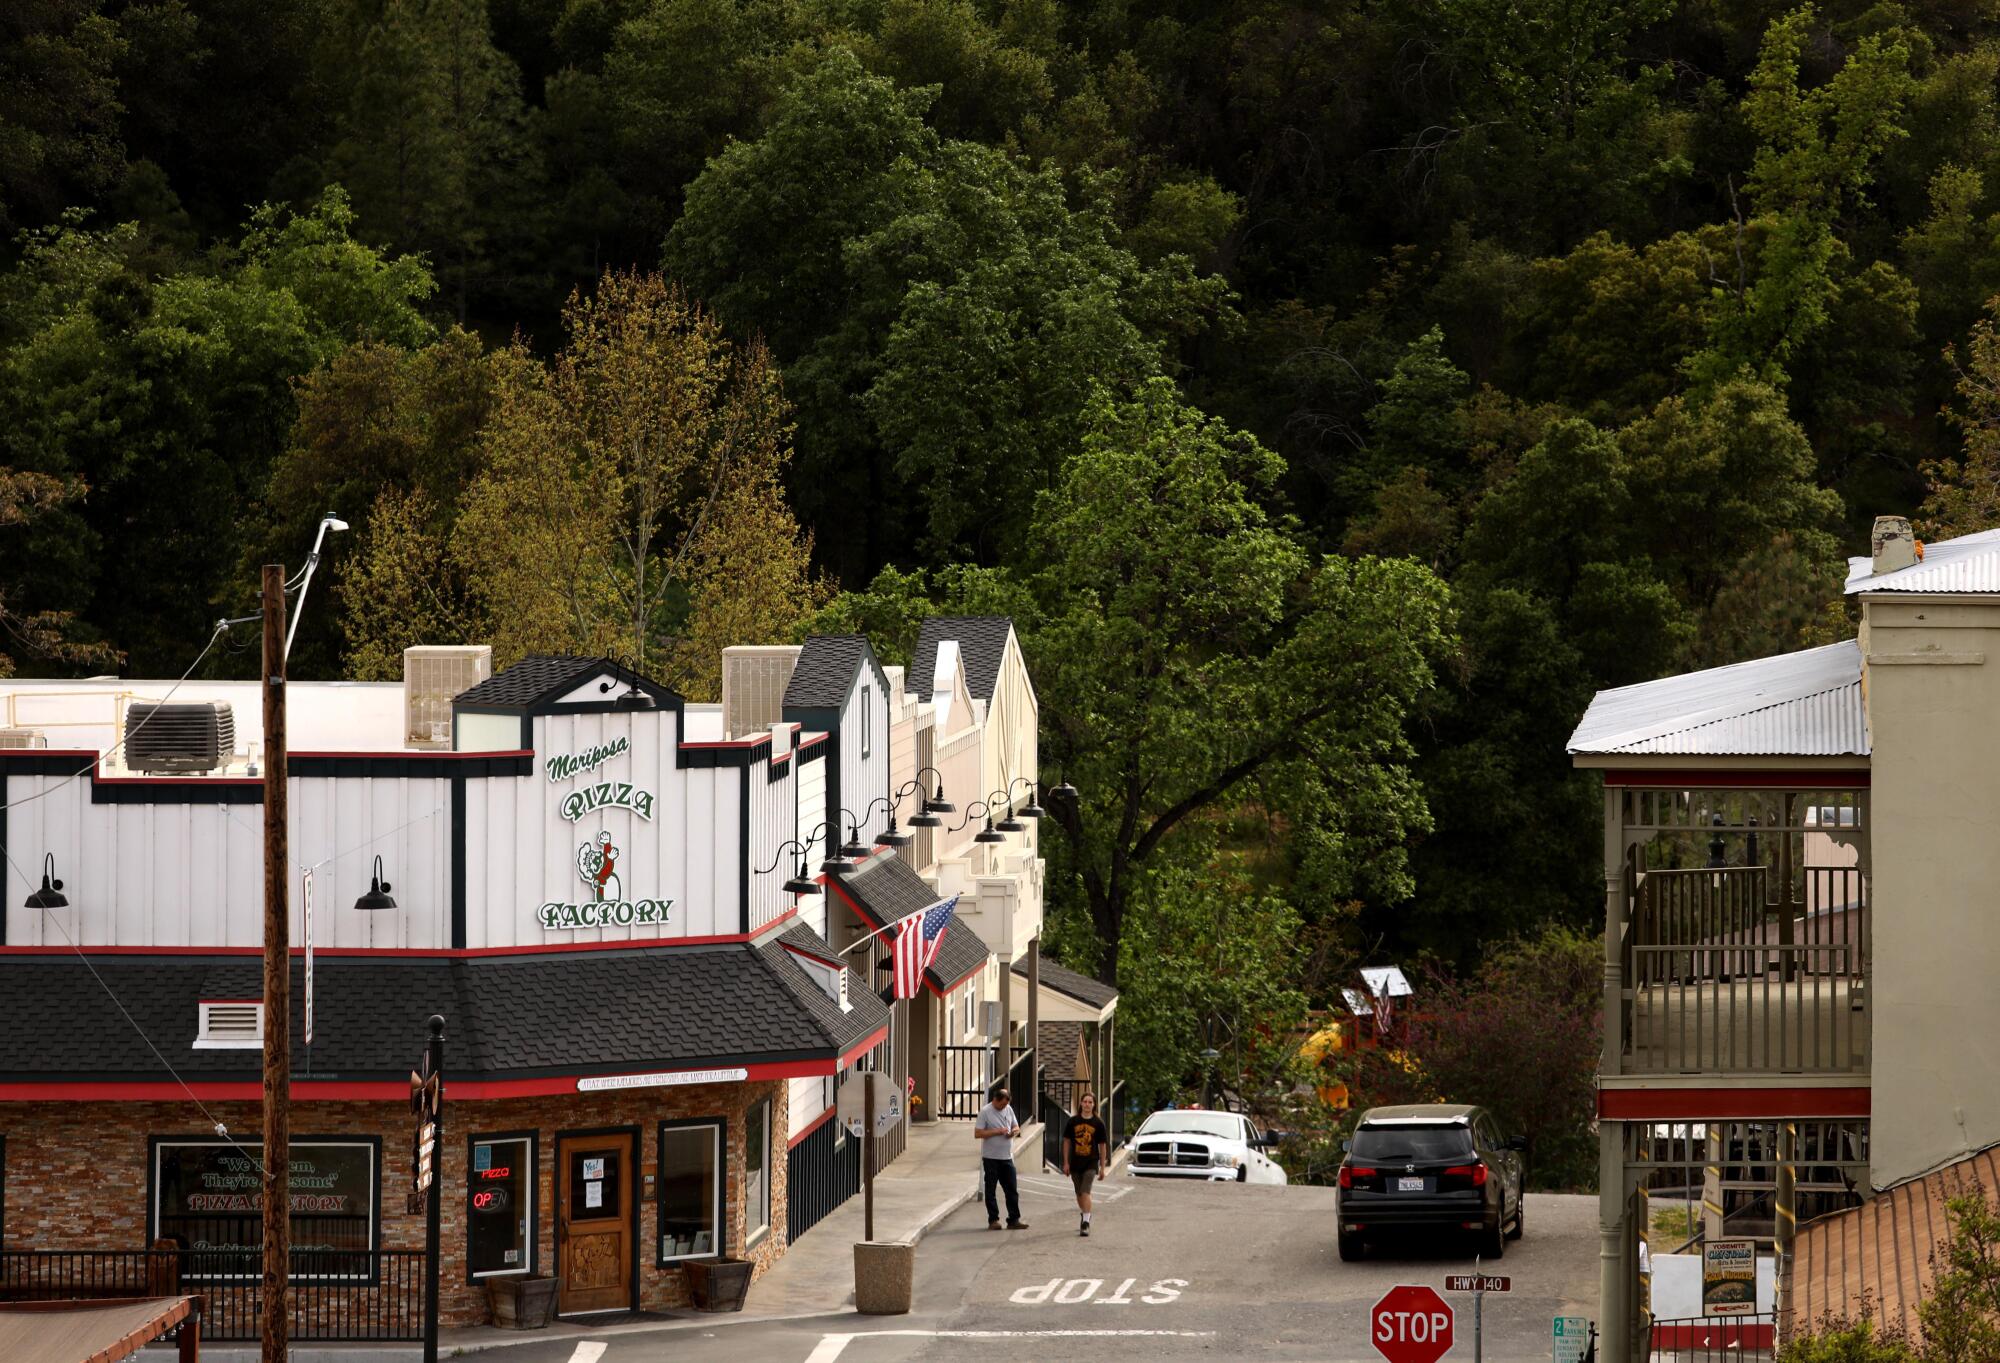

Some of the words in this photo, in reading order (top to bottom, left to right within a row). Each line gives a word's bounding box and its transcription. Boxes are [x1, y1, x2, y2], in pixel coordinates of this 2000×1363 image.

[546, 736, 629, 780] Mariposa
[563, 782, 654, 821] PIZZA
[540, 899, 674, 927] FACTORY
[189, 1194, 250, 1211] PIZZA
[253, 1194, 347, 1211] FTORY
[473, 1191, 508, 1208] OPEN
[1008, 1278, 1190, 1304] STOP
[1453, 1276, 1479, 1290] HWY
[1483, 1277, 1503, 1291] 140
[1376, 1311, 1449, 1343] STOP
[1555, 1320, 1562, 1334] 2
